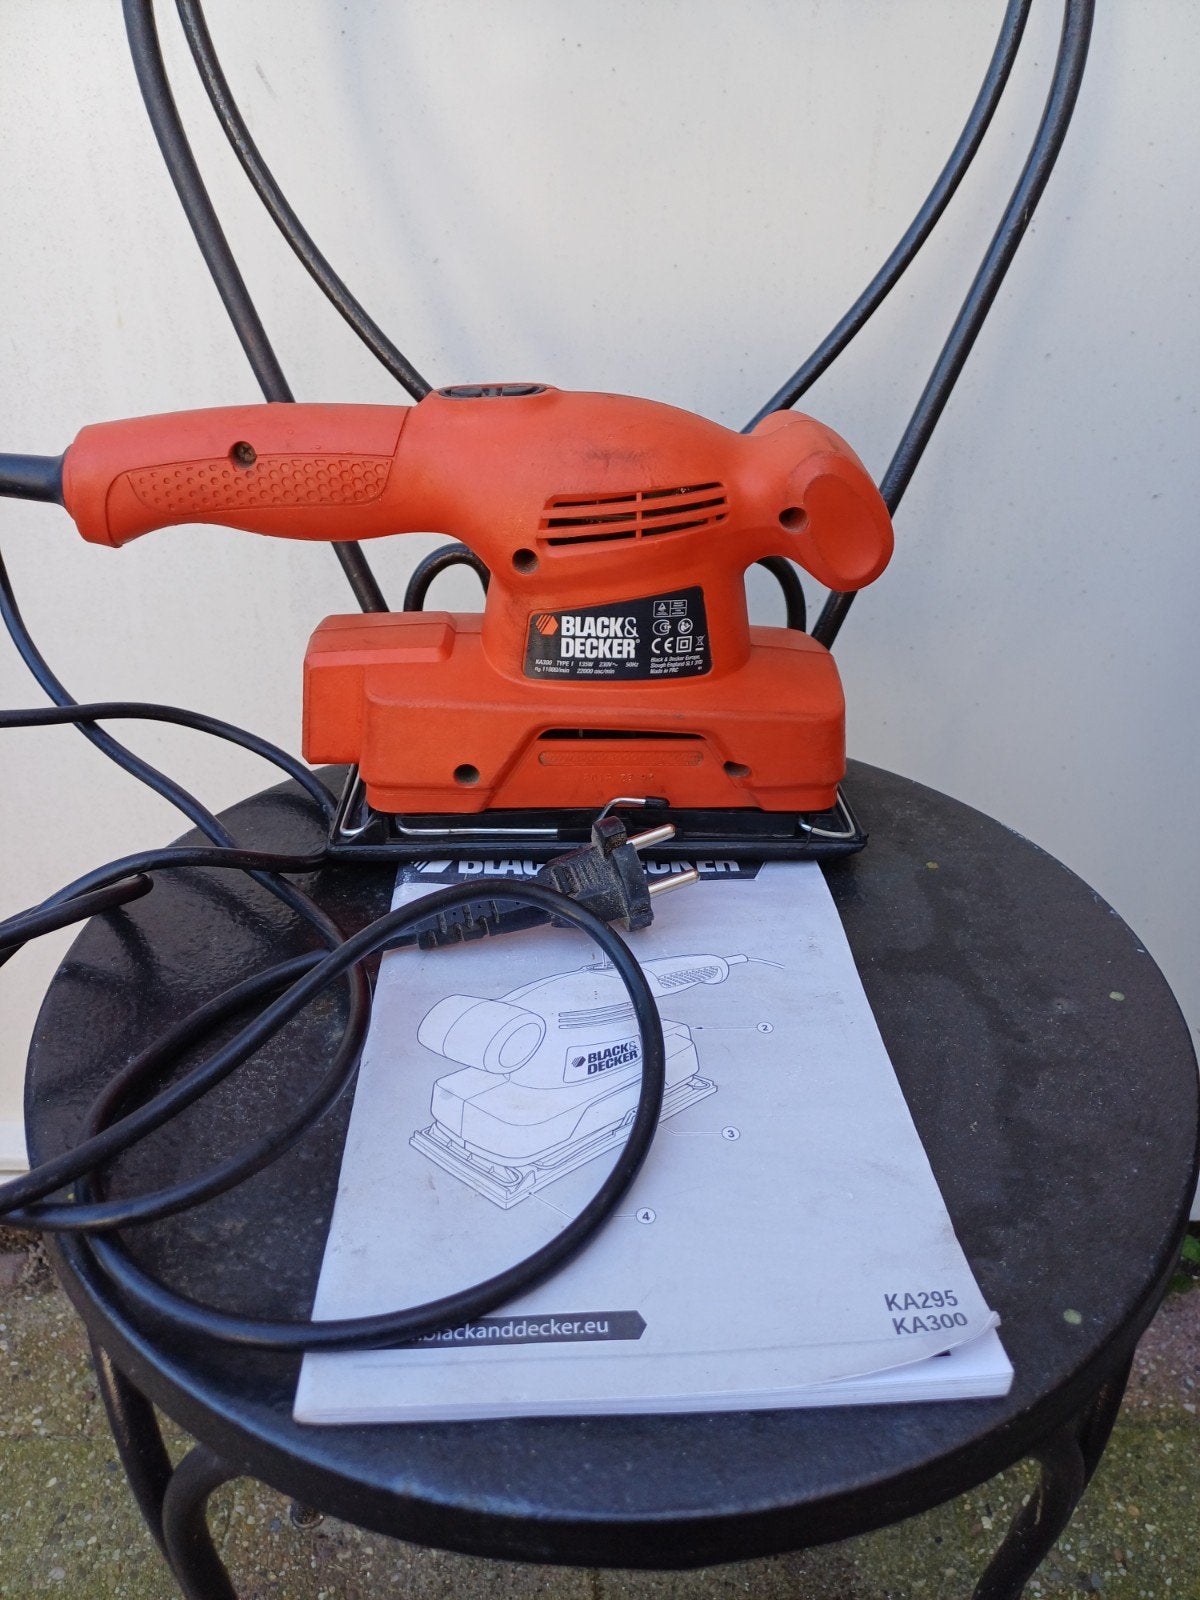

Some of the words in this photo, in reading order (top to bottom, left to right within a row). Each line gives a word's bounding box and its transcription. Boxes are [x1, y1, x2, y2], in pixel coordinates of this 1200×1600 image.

[458, 859, 546, 875] BLAC
[884, 1290, 958, 1311] KA295
[892, 1312, 968, 1335] KA300
